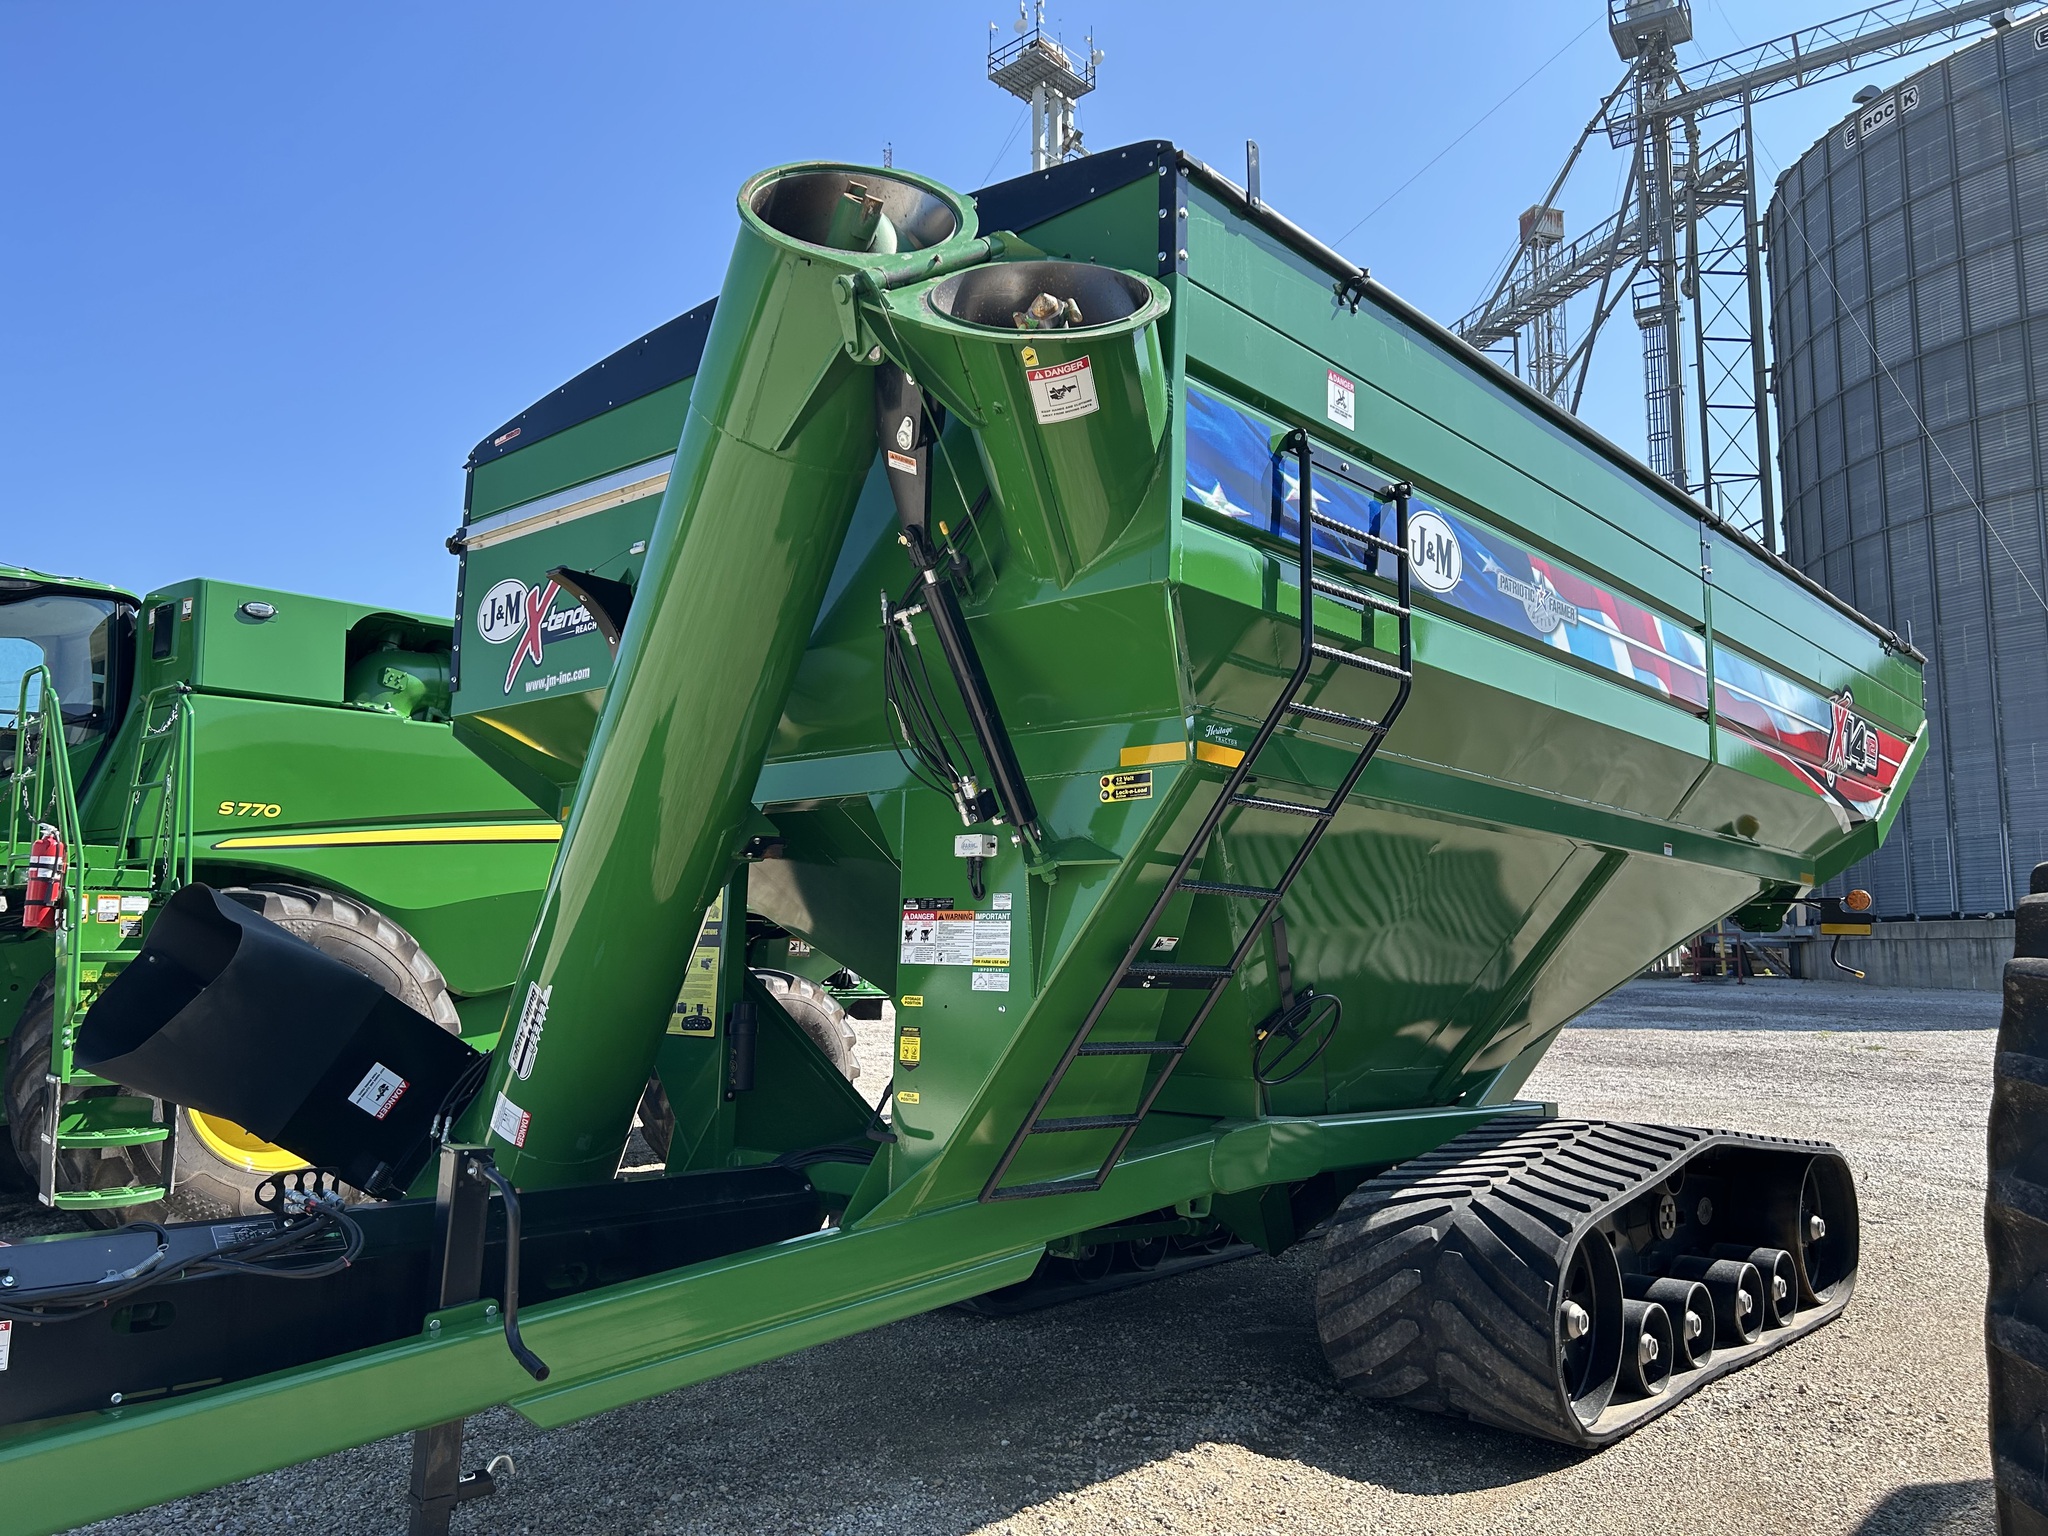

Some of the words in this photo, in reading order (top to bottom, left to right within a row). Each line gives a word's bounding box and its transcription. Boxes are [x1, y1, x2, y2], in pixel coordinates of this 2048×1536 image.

[1846, 90, 1915, 143] BROCK
[1044, 361, 1084, 378] DANGER
[1411, 526, 1454, 580] J&M
[1500, 576, 1535, 602] PATRIOTIC
[1549, 599, 1576, 621] FARMER
[483, 590, 523, 632] J&M
[574, 621, 597, 635] REACH
[525, 667, 590, 692] www.jm-inc.com
[1205, 724, 1233, 738] Heritage
[1215, 735, 1238, 746] TRACTOR
[1115, 787, 1148, 796] Lock-n-Load
[218, 801, 282, 818] S770
[910, 912, 935, 920] DANGER
[975, 912, 1011, 920] IMPORTANT
[512, 1027, 526, 1065] Auger
[377, 1088, 403, 1119] DANGER
[515, 1118, 530, 1147] DANGER
